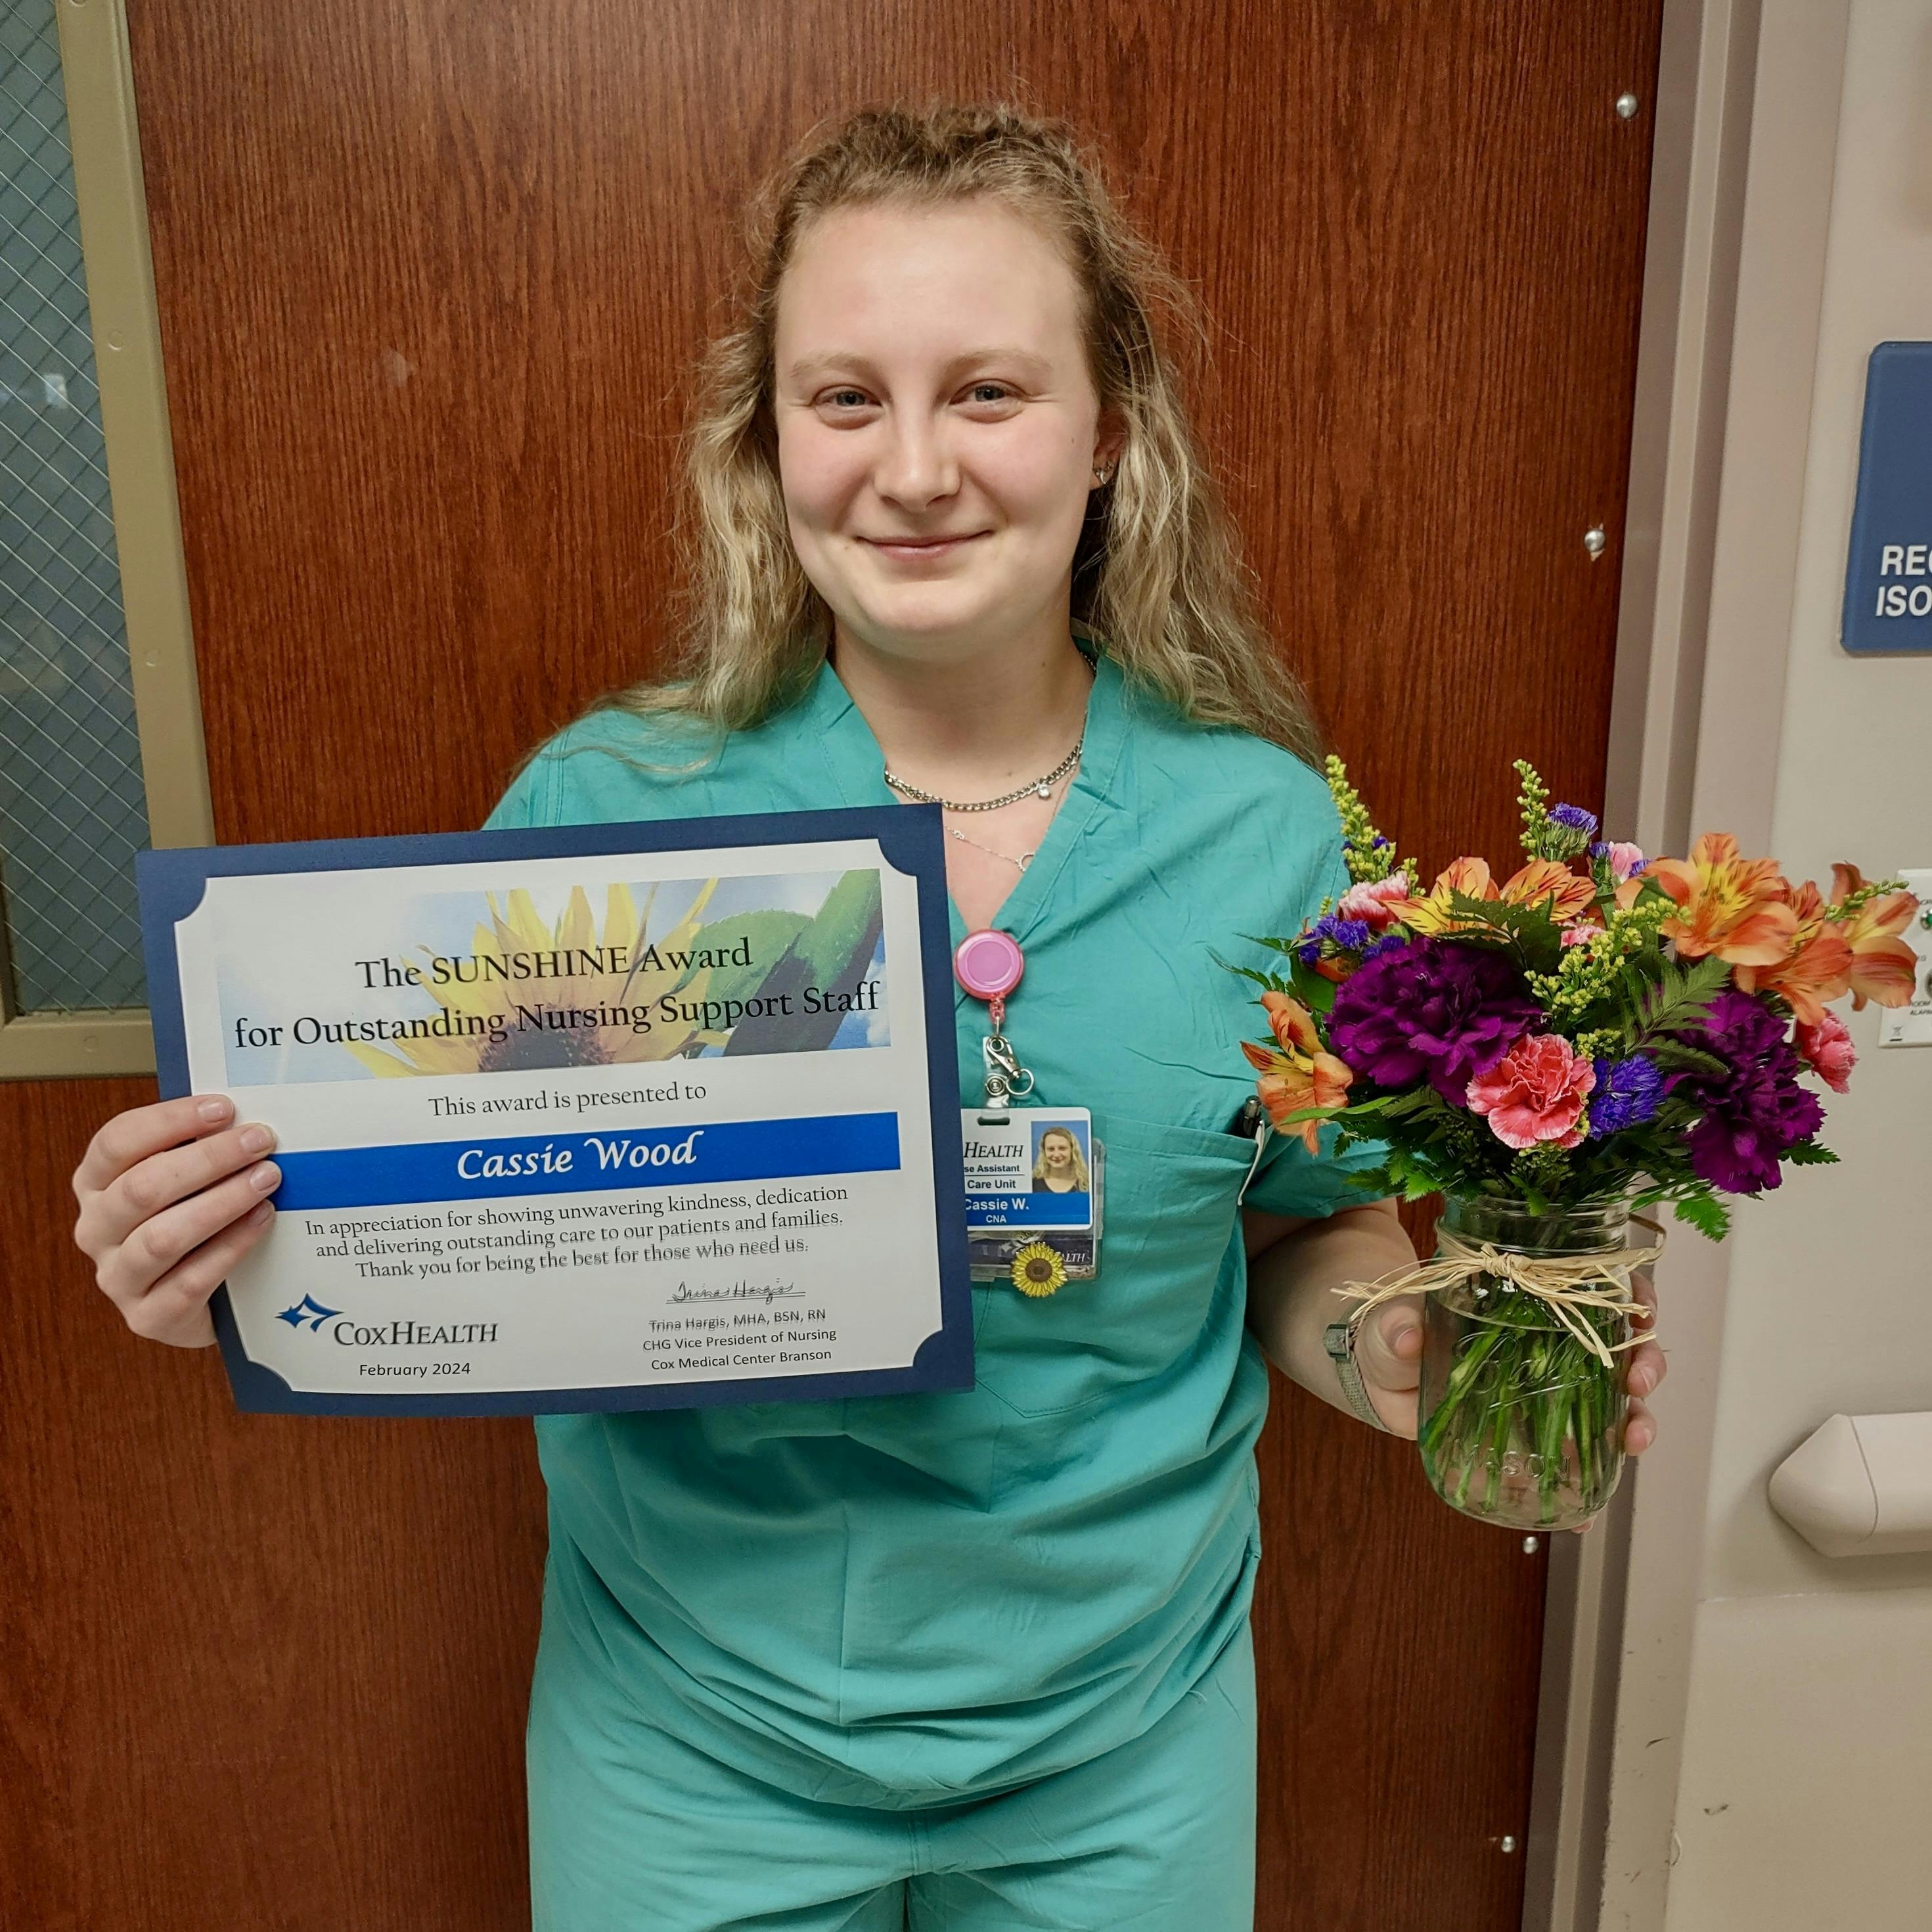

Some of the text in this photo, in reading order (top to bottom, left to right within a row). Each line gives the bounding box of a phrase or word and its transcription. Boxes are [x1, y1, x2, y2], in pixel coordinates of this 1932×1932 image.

[1880, 545, 1932, 576] RE
[355, 936, 754, 989] The SUNSHINE Award
[235, 980, 881, 1048] for Outstanding Nursing Support Staff
[428, 1081, 706, 1116] This award is presented to
[457, 1130, 705, 1179] Cassie Wood
[977, 1164, 1020, 1173] Assistant
[967, 1179, 1016, 1189] Care Unit
[304, 1186, 849, 1239] In appreciation for showing unwavering kindness, dedication
[965, 1198, 1030, 1210] Cassie W.
[316, 1209, 843, 1257] and delivering outstanding care to our patients and families.
[985, 1215, 1007, 1223] CNA
[354, 1236, 809, 1279] Thank you for being the best for those who need us.
[648, 1308, 826, 1333] Trina Hargis, MHA, BSN, RN
[642, 1329, 837, 1351] CHG Vice President of Nursing
[359, 1362, 471, 1378] February 2024
[651, 1351, 832, 1370] Cox Medical Center Branson
